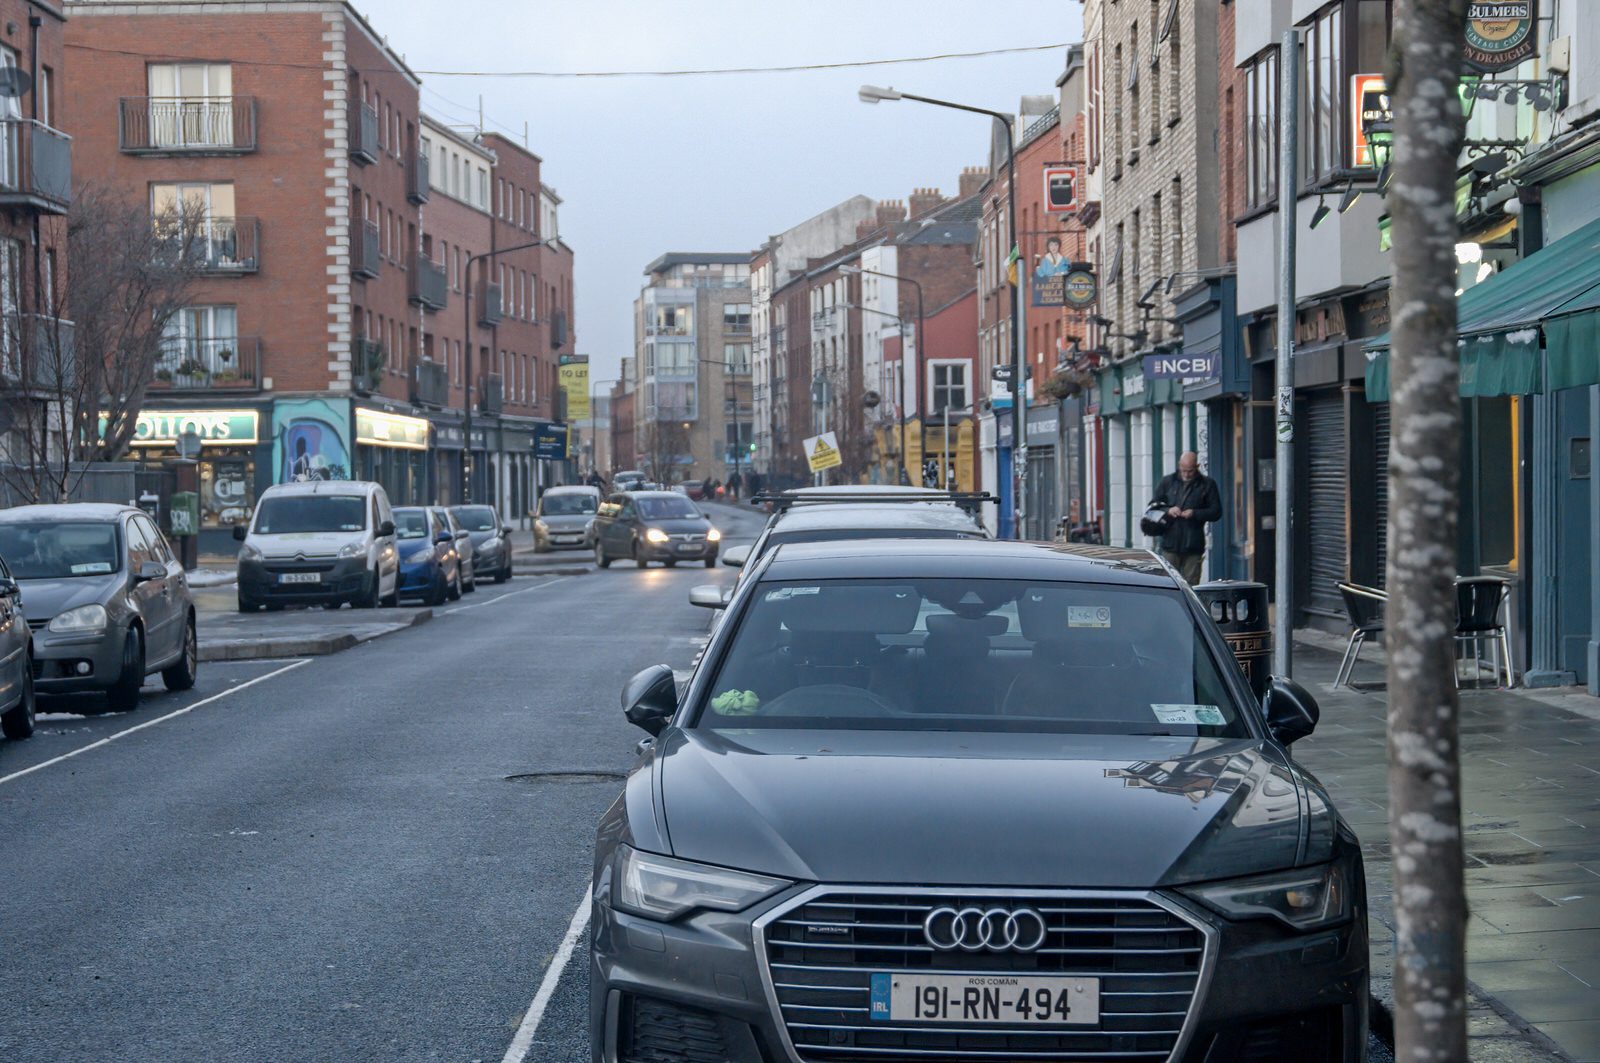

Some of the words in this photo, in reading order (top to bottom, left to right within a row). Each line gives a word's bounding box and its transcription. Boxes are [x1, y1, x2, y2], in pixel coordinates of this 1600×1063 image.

[1468, 4, 1527, 17] BULMERS
[1466, 26, 1499, 48] VINTAGE
[1503, 26, 1526, 46] CIDER
[1477, 41, 1532, 64] DRAUGHT
[1162, 359, 1211, 373] NCBI
[134, 417, 231, 440] OLLOYS
[969, 977, 986, 986] ROS
[873, 1001, 889, 1013] IRL
[915, 985, 1071, 1021] 191-RN-494
